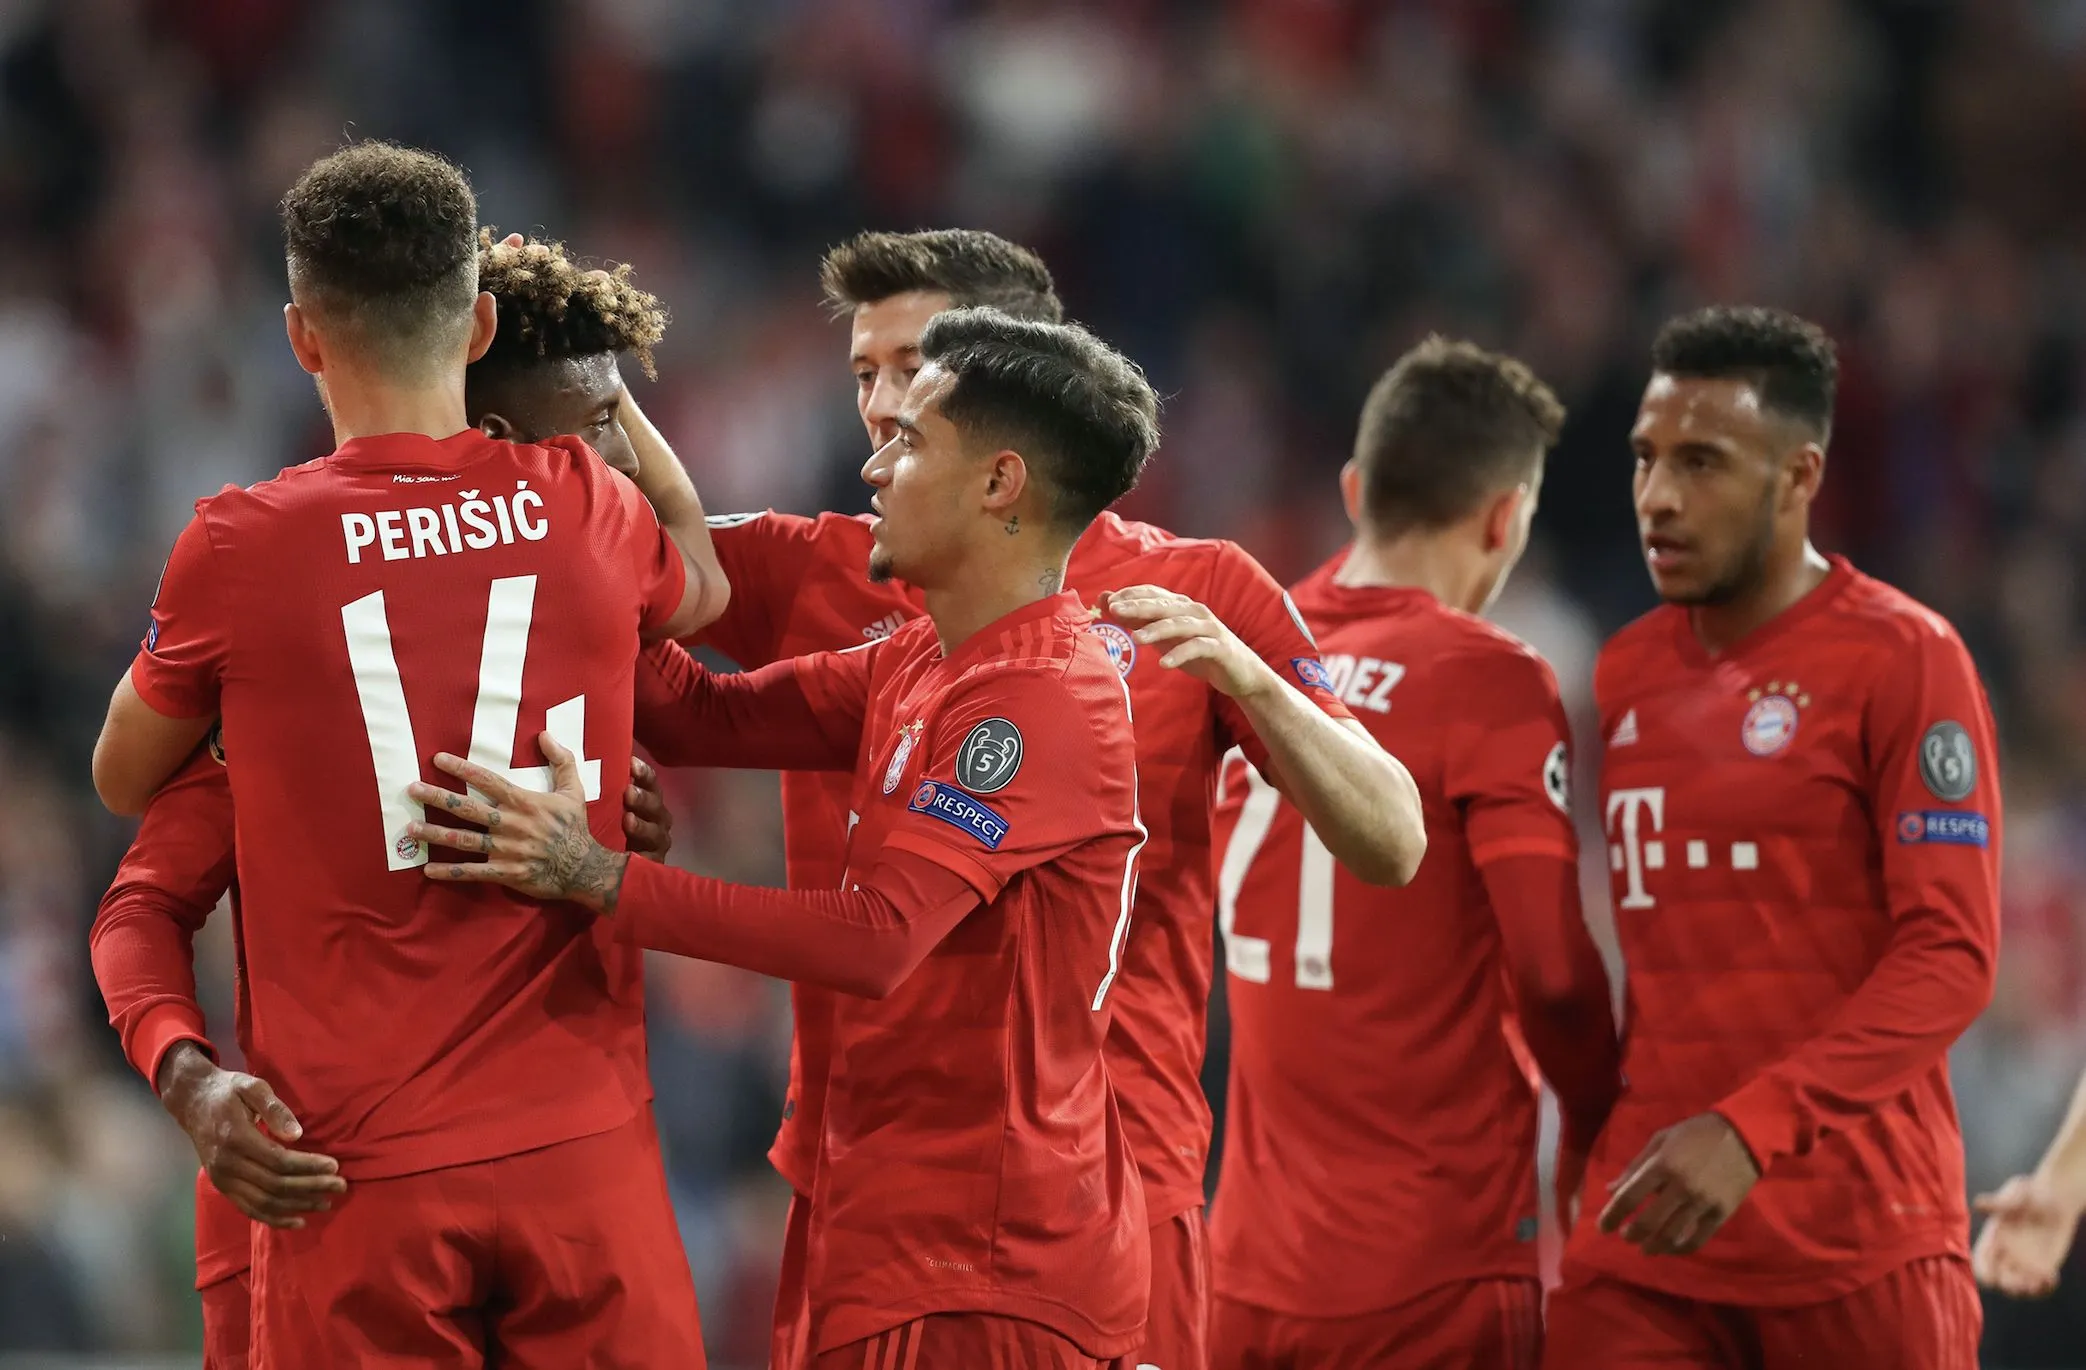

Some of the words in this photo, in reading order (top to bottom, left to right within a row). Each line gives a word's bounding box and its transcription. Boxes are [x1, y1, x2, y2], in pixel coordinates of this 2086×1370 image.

[392, 474, 415, 483] Mia
[340, 480, 549, 565] PERIŠIĆ
[340, 574, 602, 872] 14
[975, 753, 995, 772] 5
[933, 793, 1005, 841] RESPECT
[1216, 744, 1336, 991] 21
